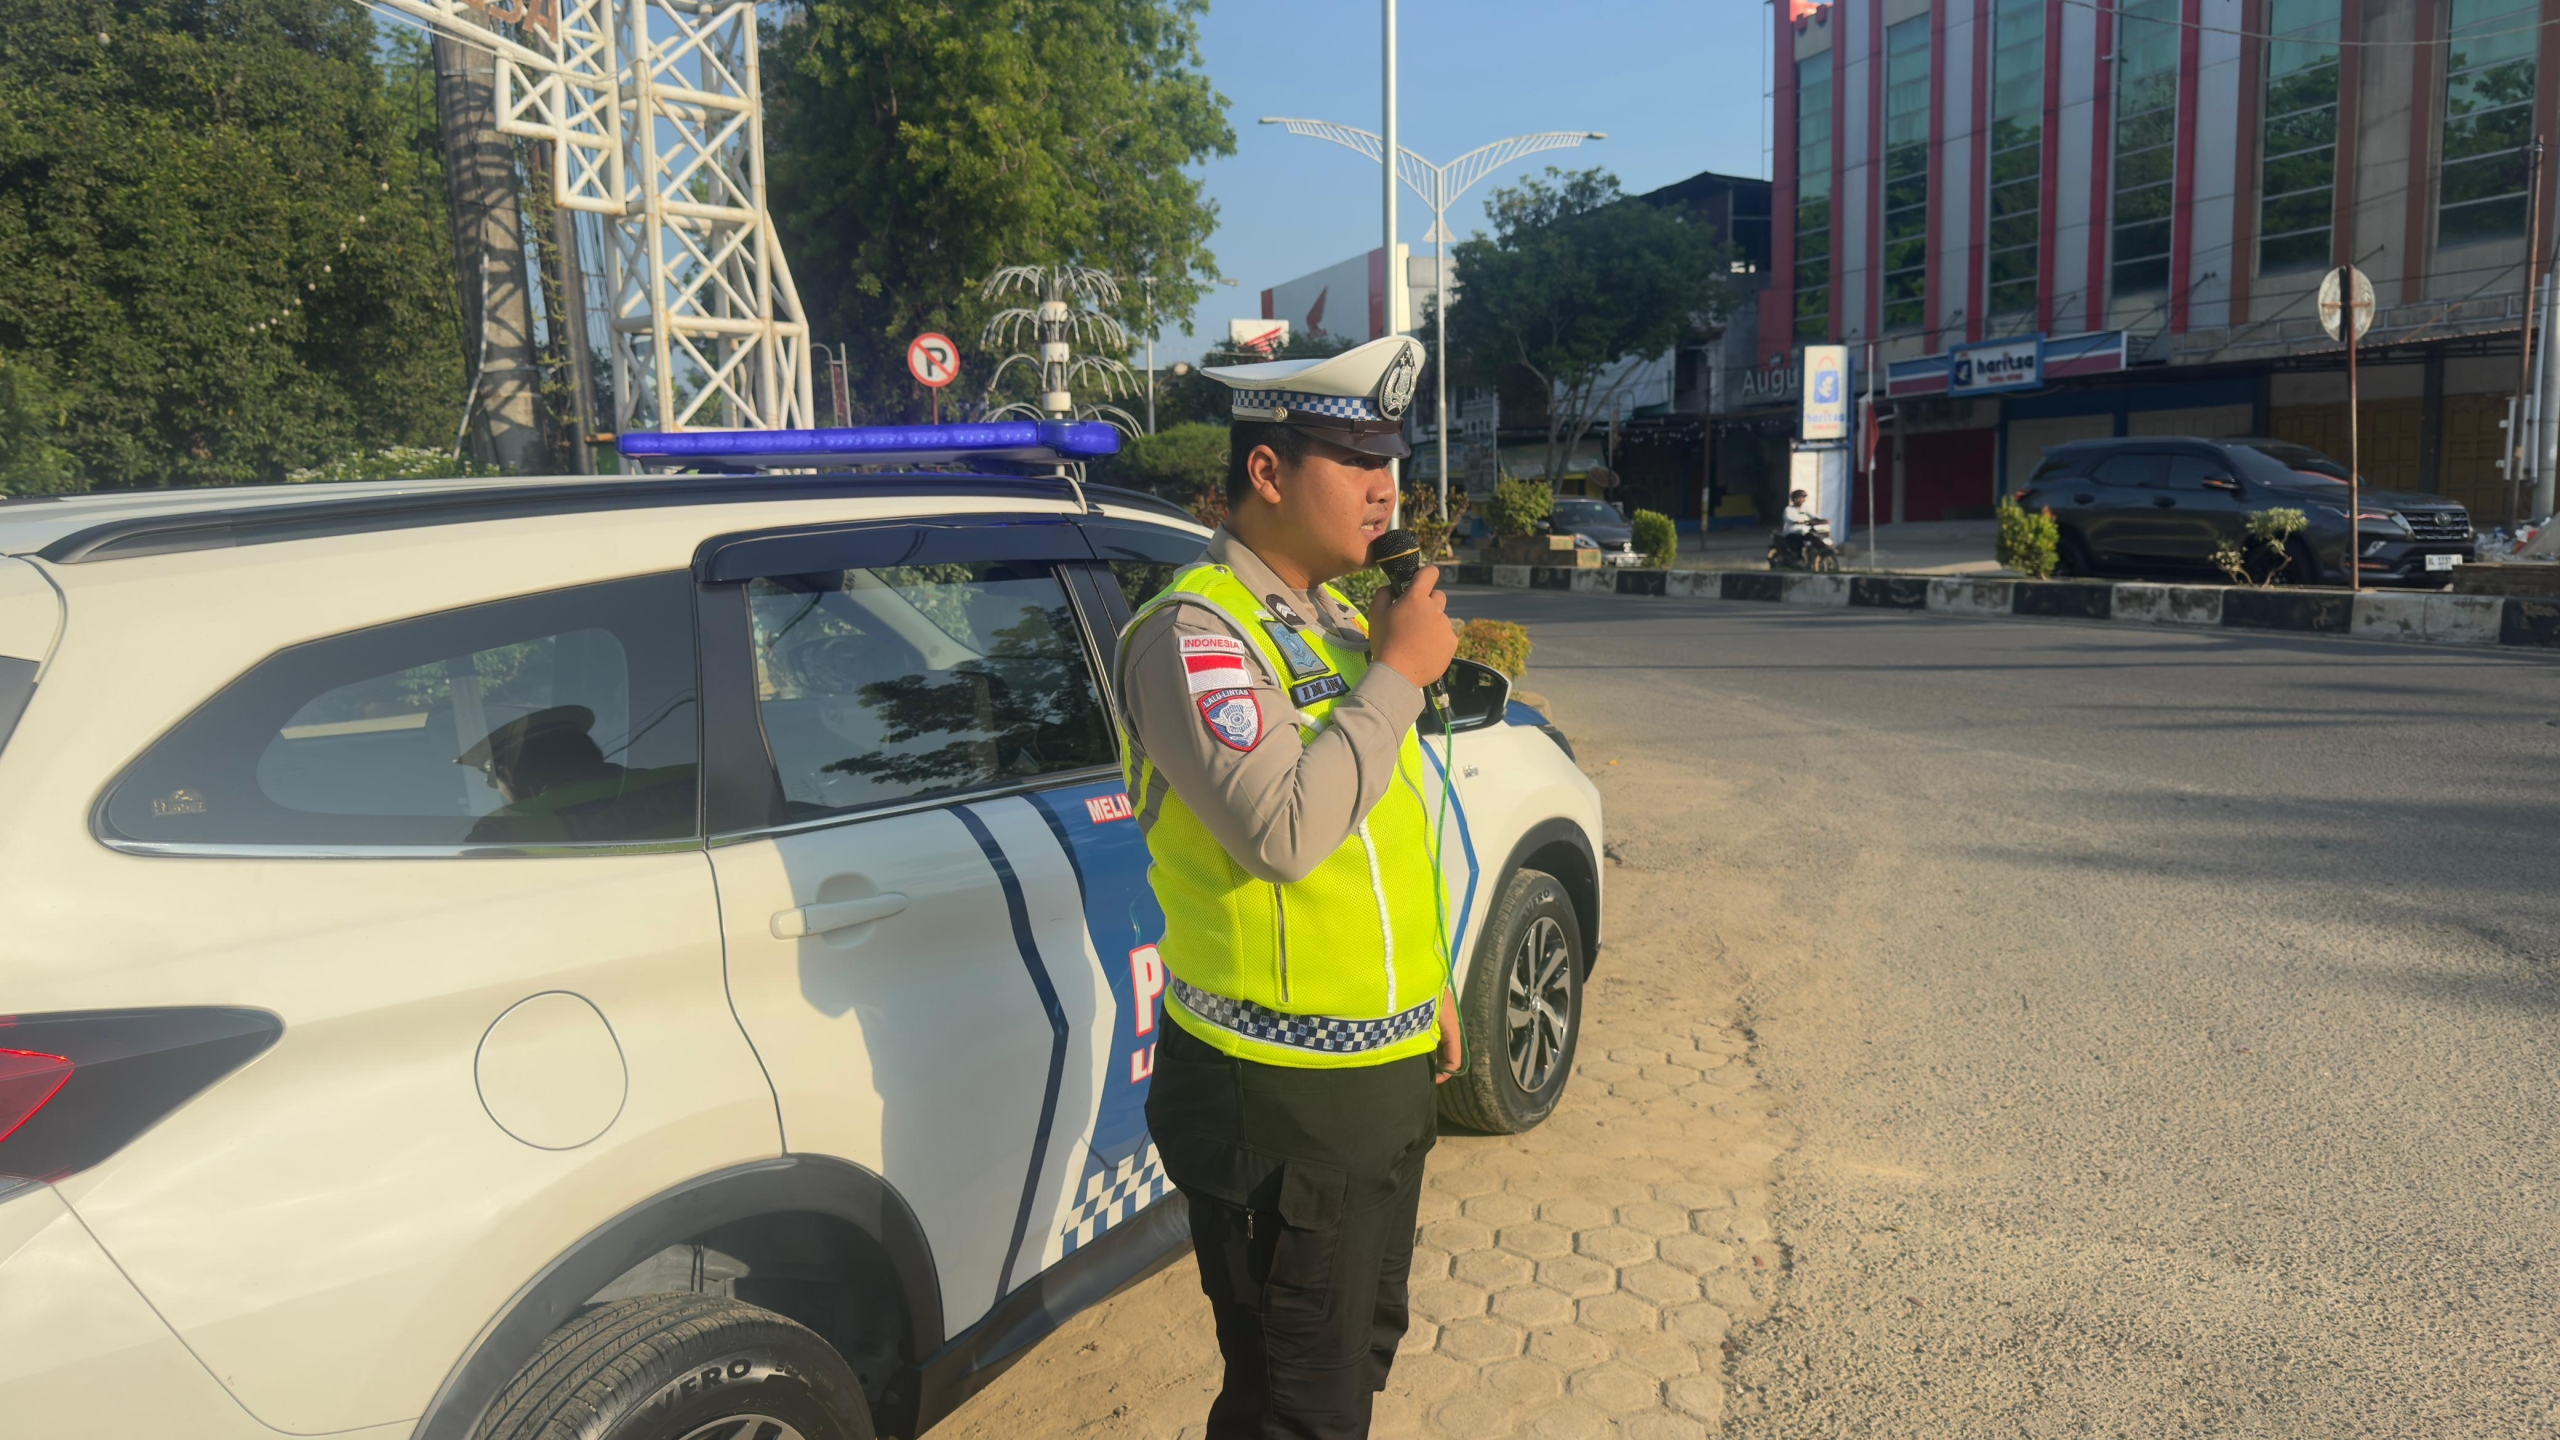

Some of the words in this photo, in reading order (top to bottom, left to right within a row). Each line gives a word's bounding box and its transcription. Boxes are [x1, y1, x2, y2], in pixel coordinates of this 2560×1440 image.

[926, 347, 947, 377] P
[1184, 638, 1241, 649] INDONESIA
[1129, 943, 1165, 1037] P
